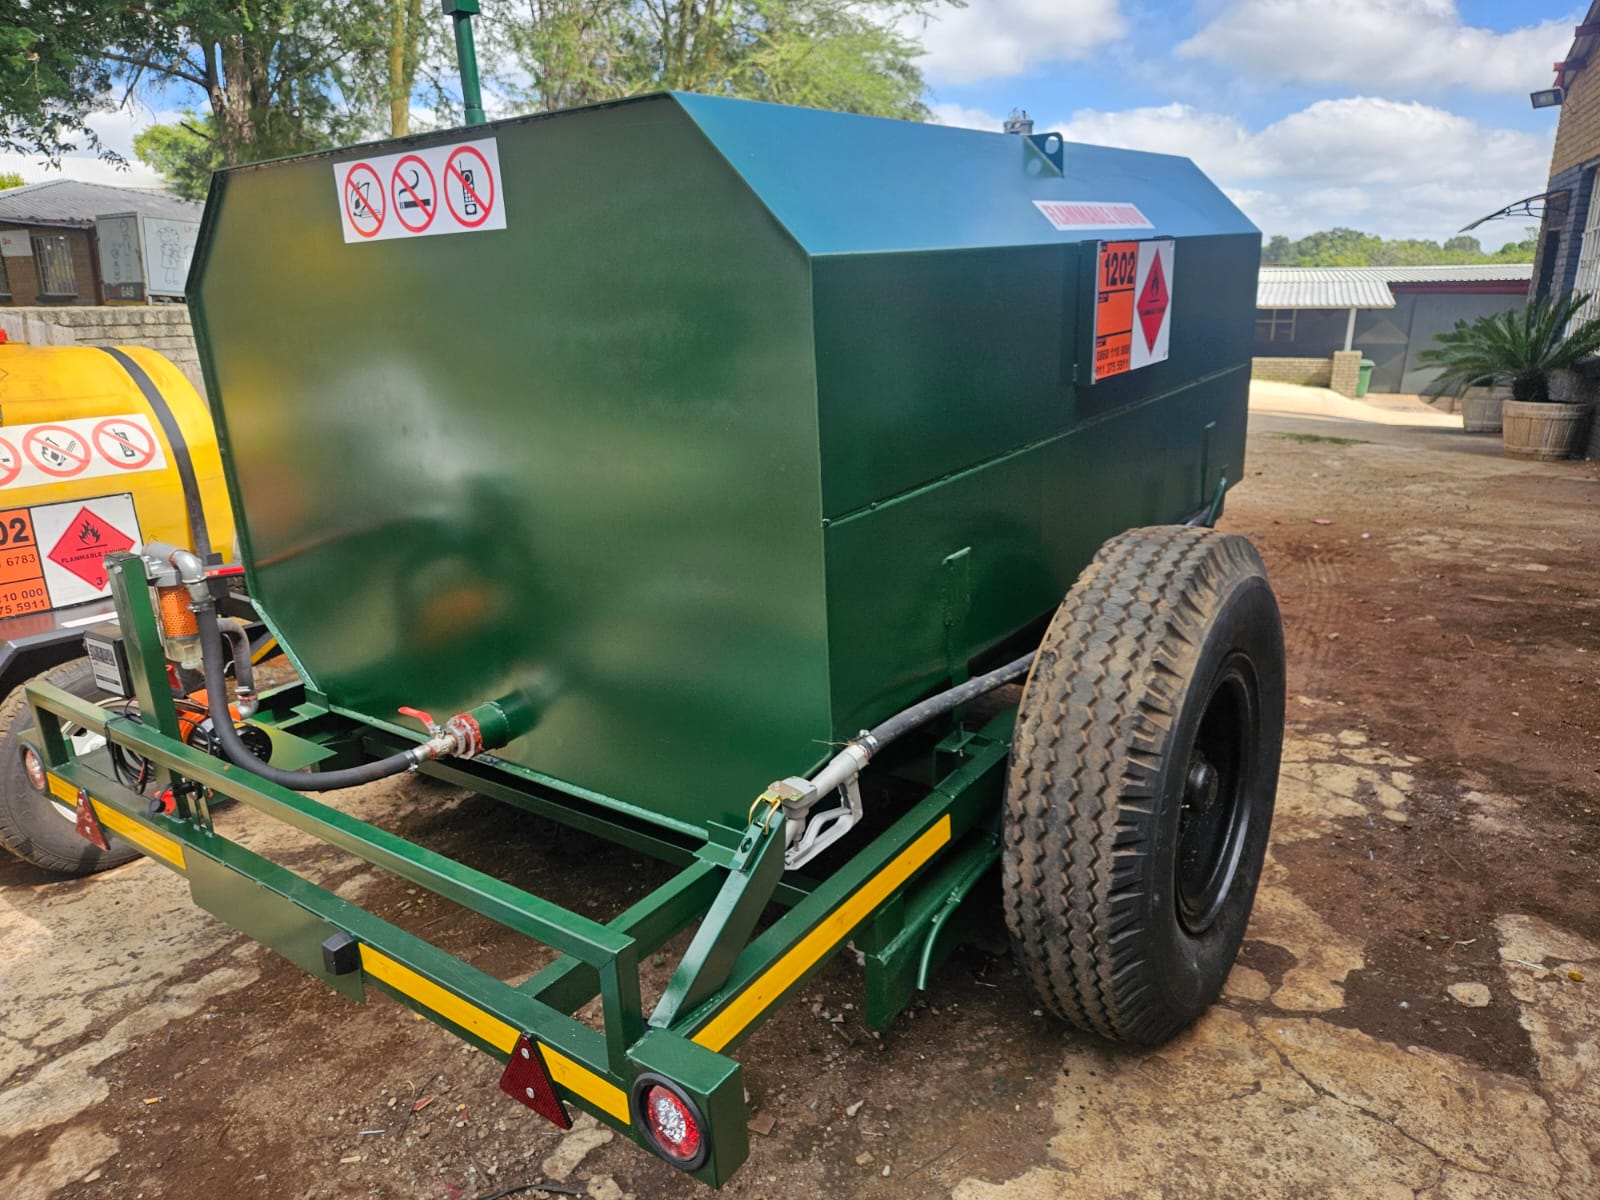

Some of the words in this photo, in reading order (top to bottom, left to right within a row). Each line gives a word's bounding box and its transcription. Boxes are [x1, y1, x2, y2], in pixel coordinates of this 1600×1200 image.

[1105, 251, 1135, 287] 1202
[7, 554, 35, 567] 6783
[97, 577, 103, 585] 3
[0, 592, 17, 603] 10
[22, 588, 43, 599] 000
[17, 599, 45, 611] 5911
